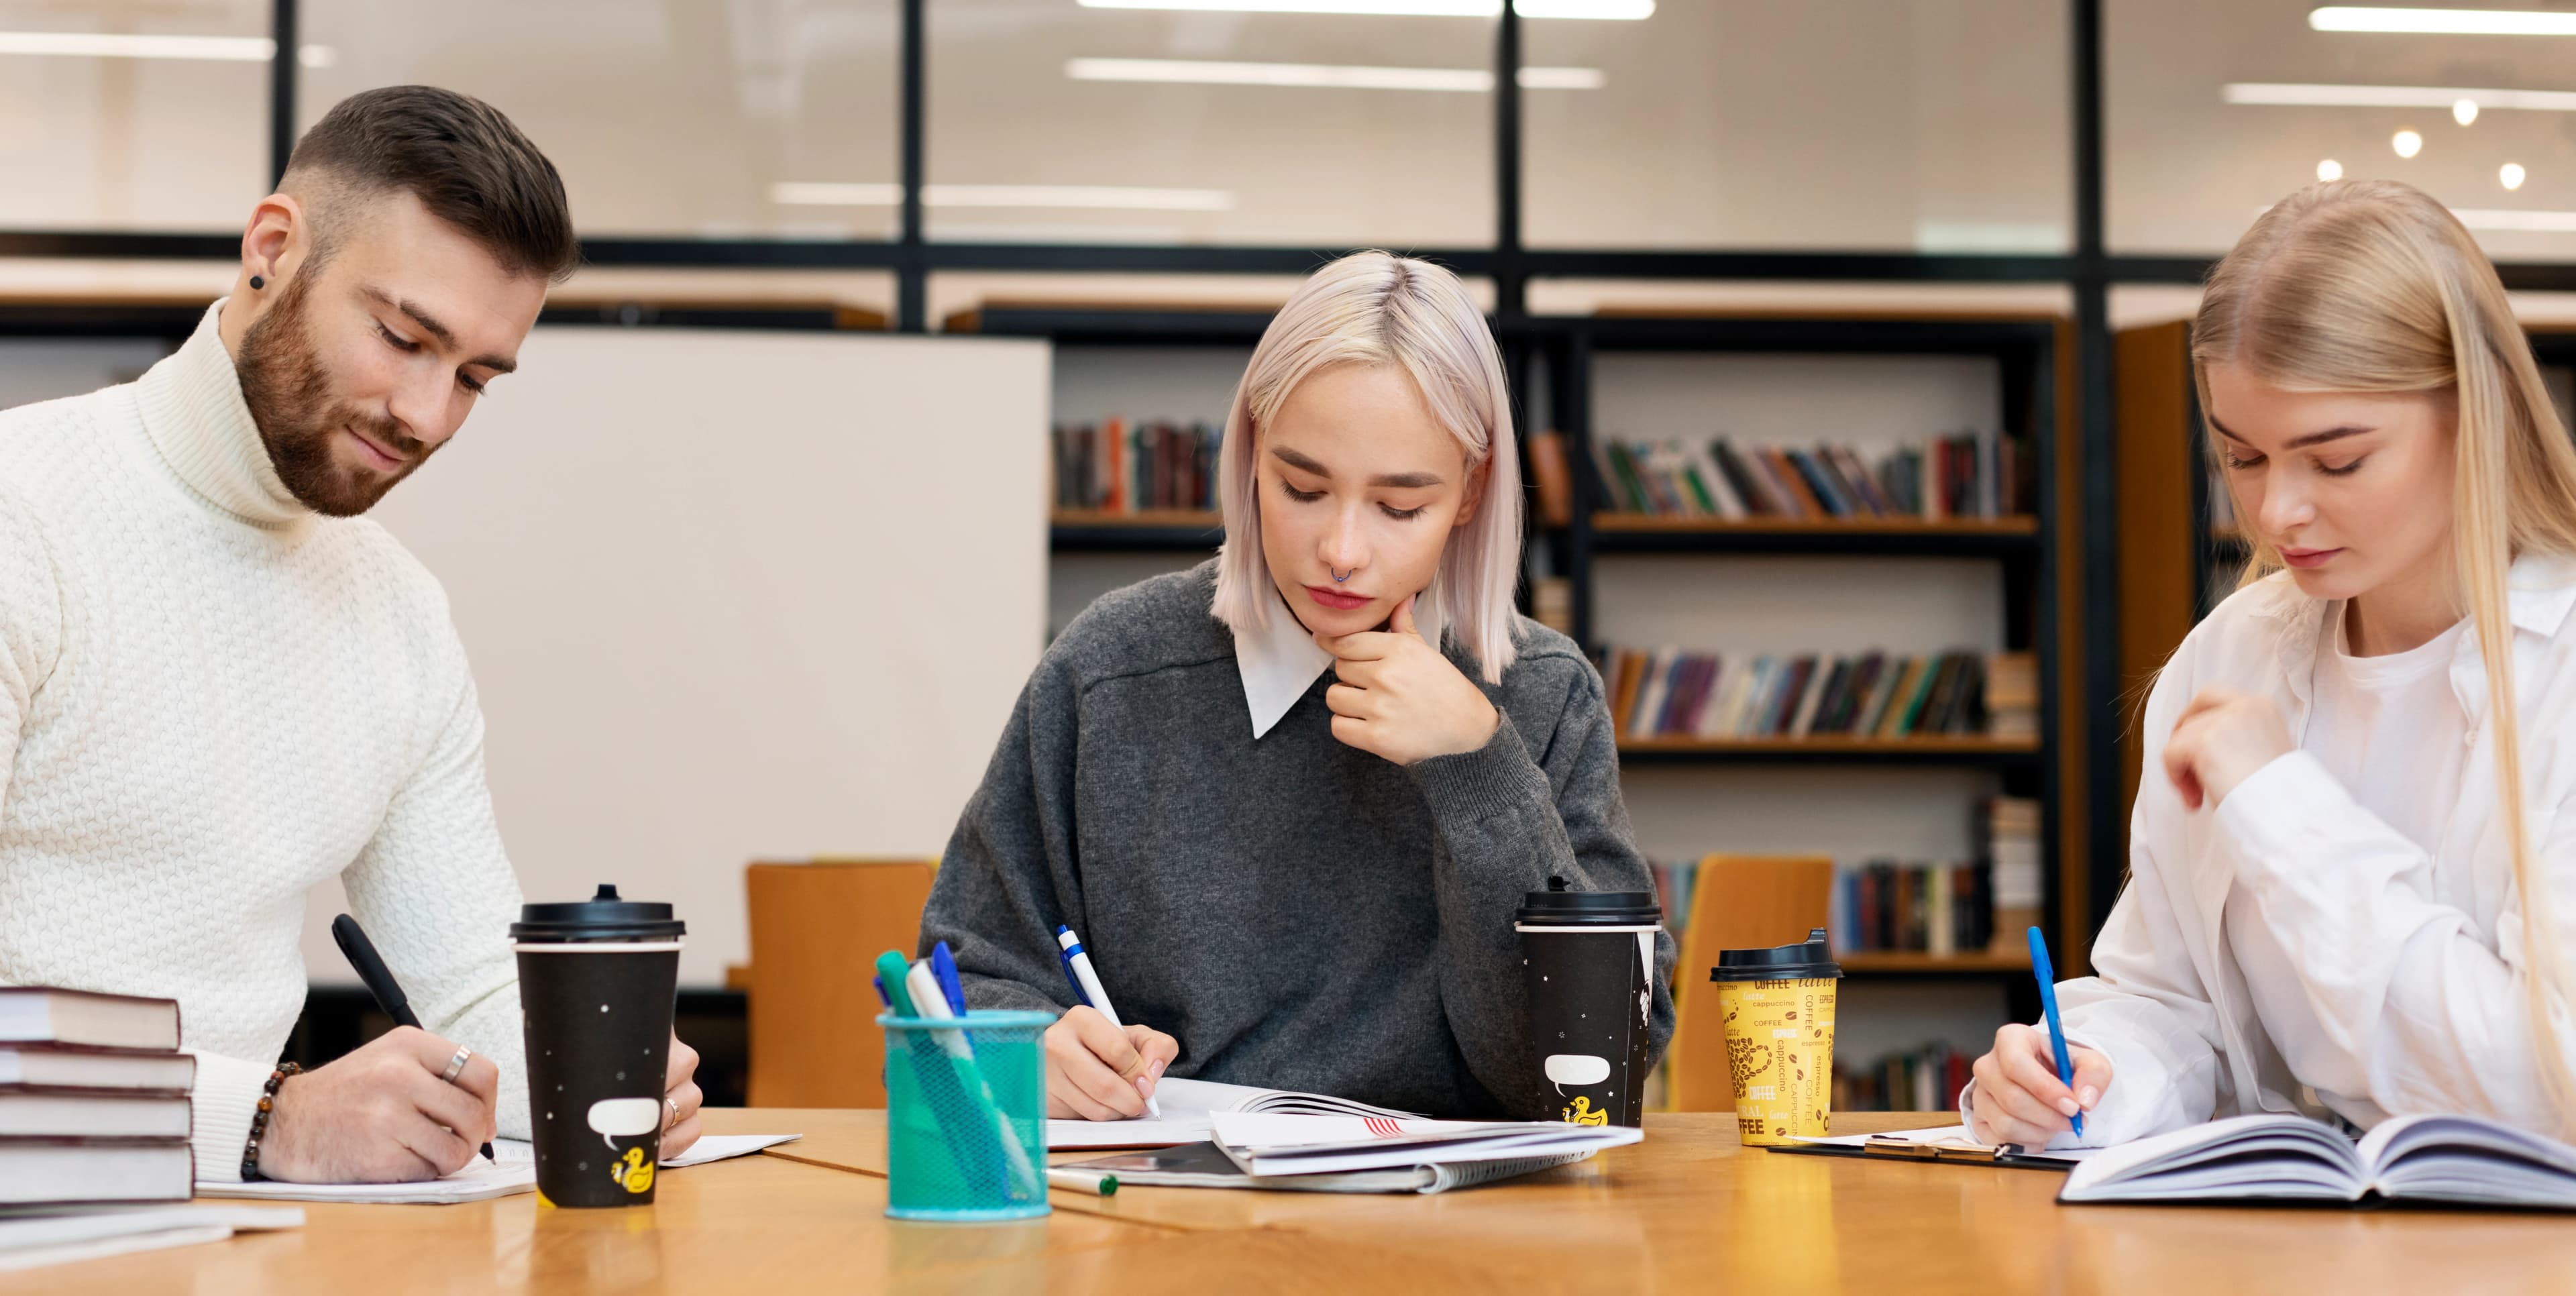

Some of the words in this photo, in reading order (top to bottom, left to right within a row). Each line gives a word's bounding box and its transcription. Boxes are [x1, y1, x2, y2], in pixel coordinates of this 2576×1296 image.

[1805, 995, 1814, 1031] COFFEE
[1776, 1040, 1788, 1092] cappuccino
[1749, 1085, 1776, 1101] COFFEE
[1805, 1079, 1813, 1126] COFFEE
